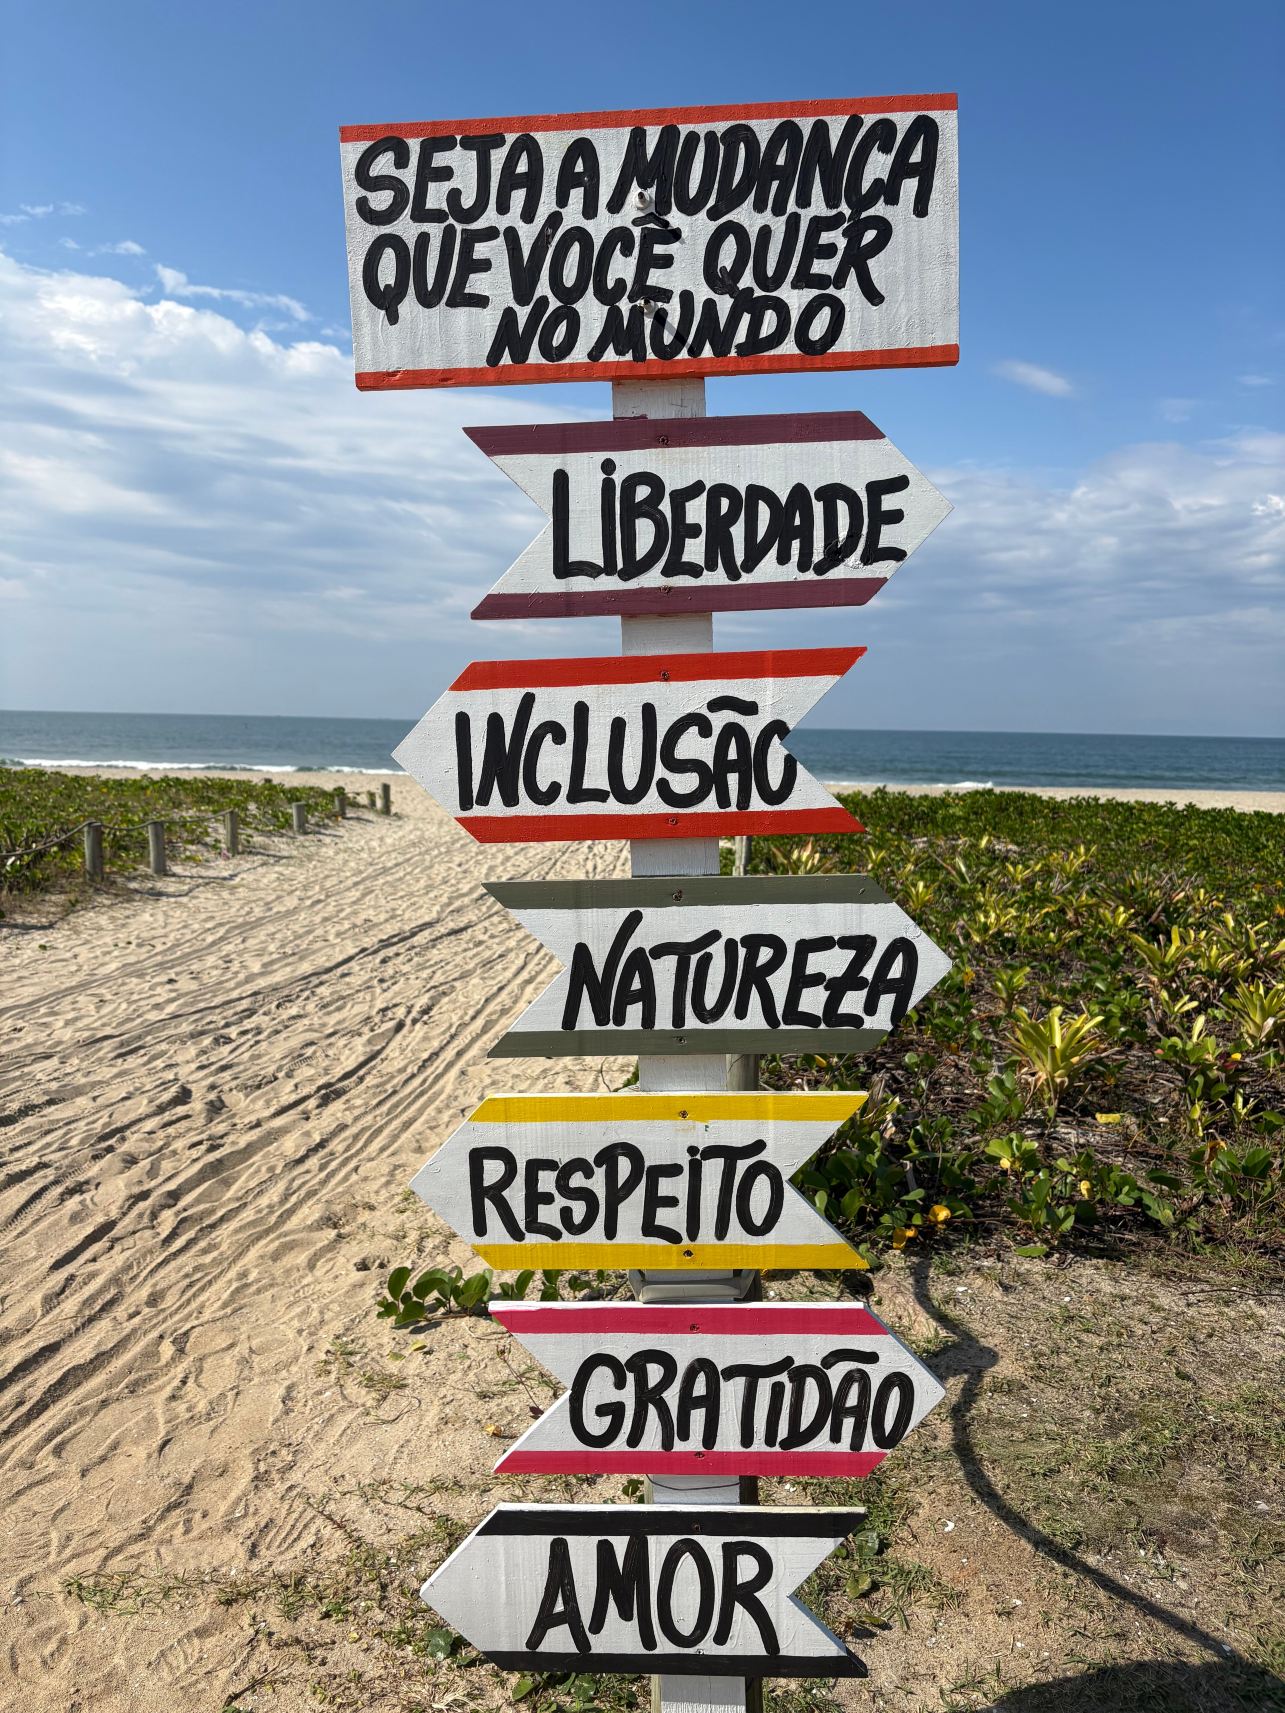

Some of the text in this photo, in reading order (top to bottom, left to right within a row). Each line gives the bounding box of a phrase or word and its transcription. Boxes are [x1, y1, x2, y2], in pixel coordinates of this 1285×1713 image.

[355, 133, 544, 225] SEJA
[556, 135, 600, 220] A
[362, 211, 894, 326] QUE VOCÊ QUER
[486, 287, 846, 368] NO MUNDO
[552, 458, 910, 581] LIBERDADE
[455, 692, 797, 811] INCLUSÃO
[561, 910, 918, 1030] NATUREZA
[468, 1139, 785, 1244] RESPEITO
[569, 1349, 914, 1451] GRATIDÃO
[525, 1534, 780, 1656] AMOR
